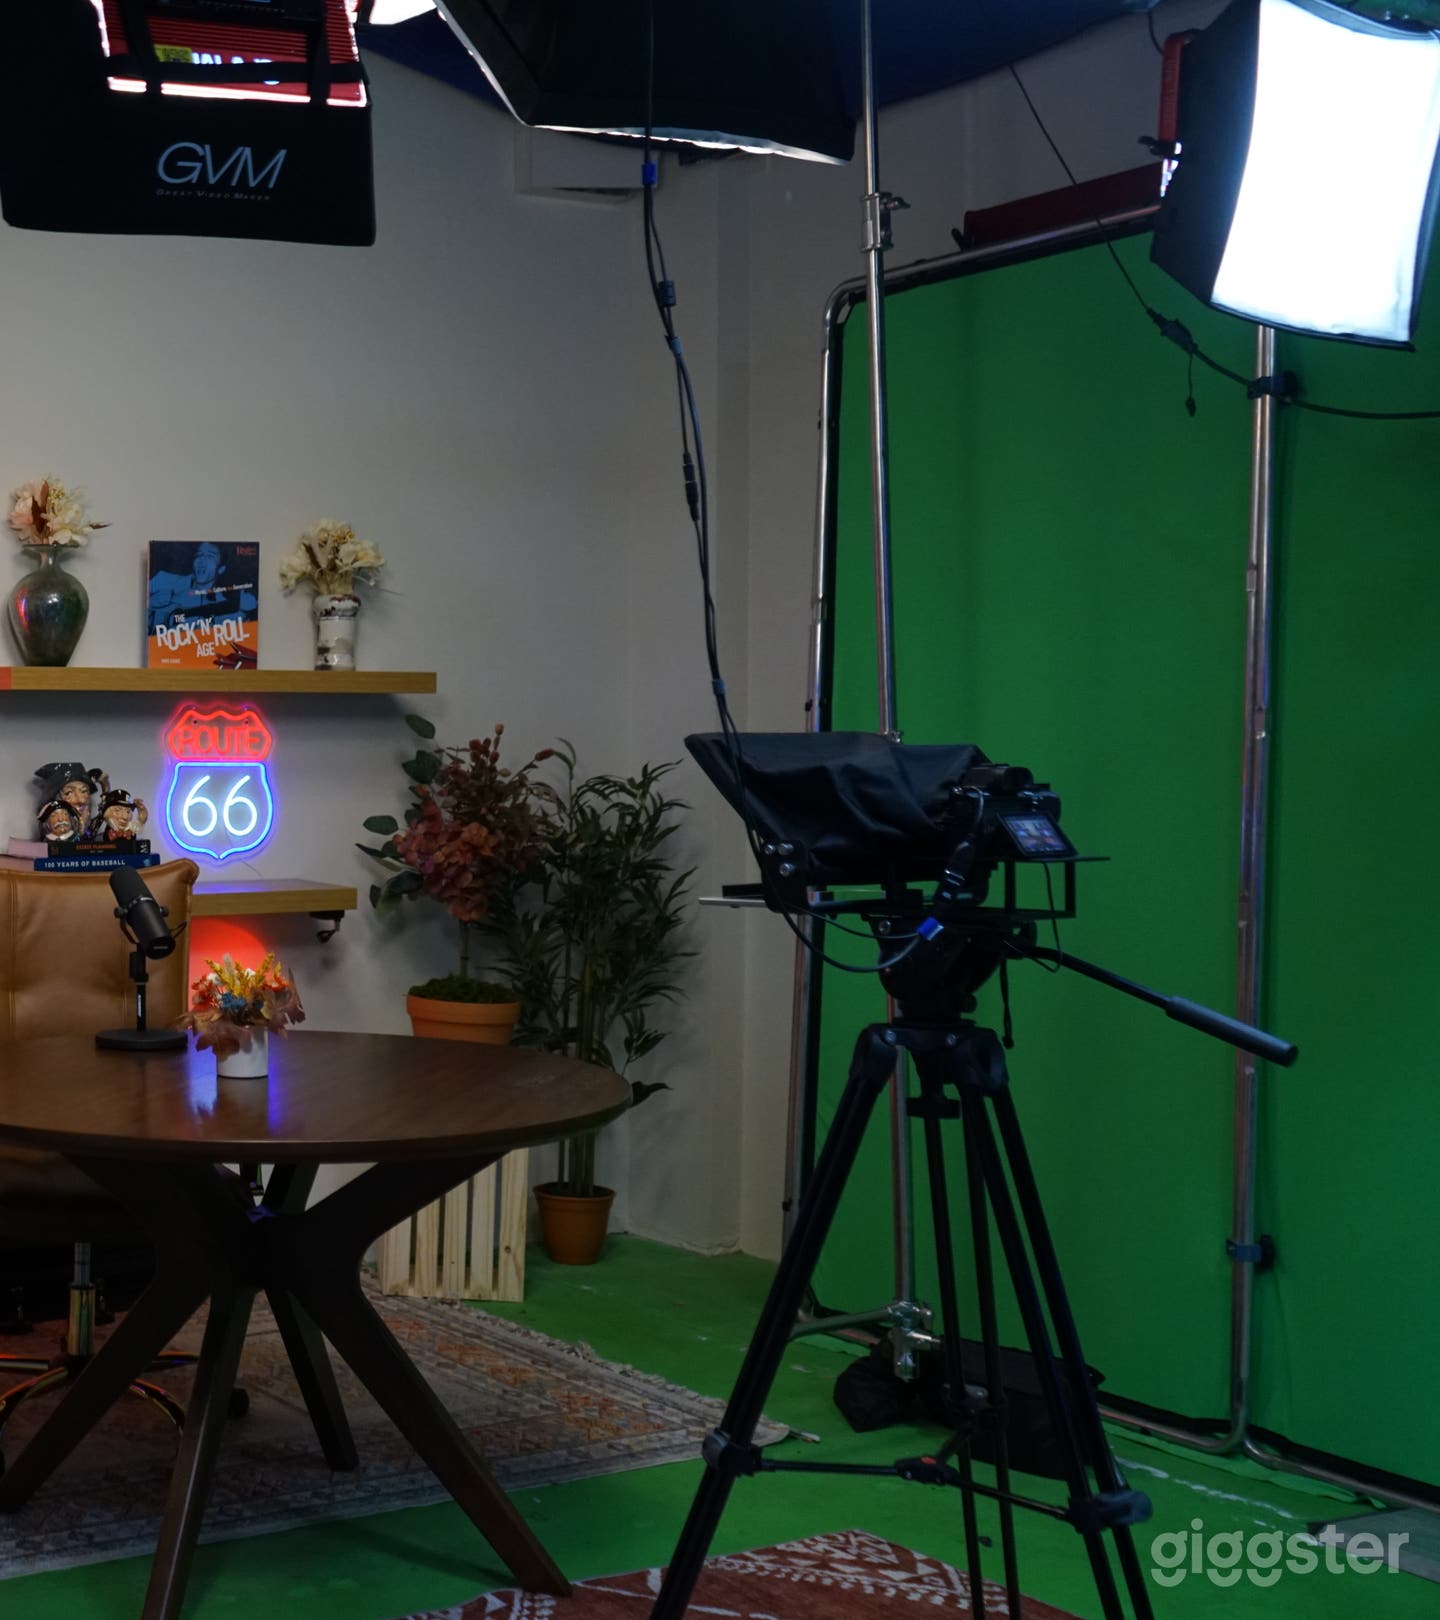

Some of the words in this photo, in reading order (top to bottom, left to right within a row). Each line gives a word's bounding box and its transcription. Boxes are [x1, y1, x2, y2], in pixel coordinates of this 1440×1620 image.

[157, 142, 288, 189] GVM
[155, 621, 199, 651] ROCK
[213, 616, 250, 647] ROLL
[175, 614, 185, 623] THE
[196, 642, 215, 657] AGE
[177, 724, 261, 756] ROUTE
[183, 775, 258, 836] 66
[44, 861, 55, 869] 100
[56, 861, 79, 869] YEARS
[92, 859, 126, 867] BASEBALL
